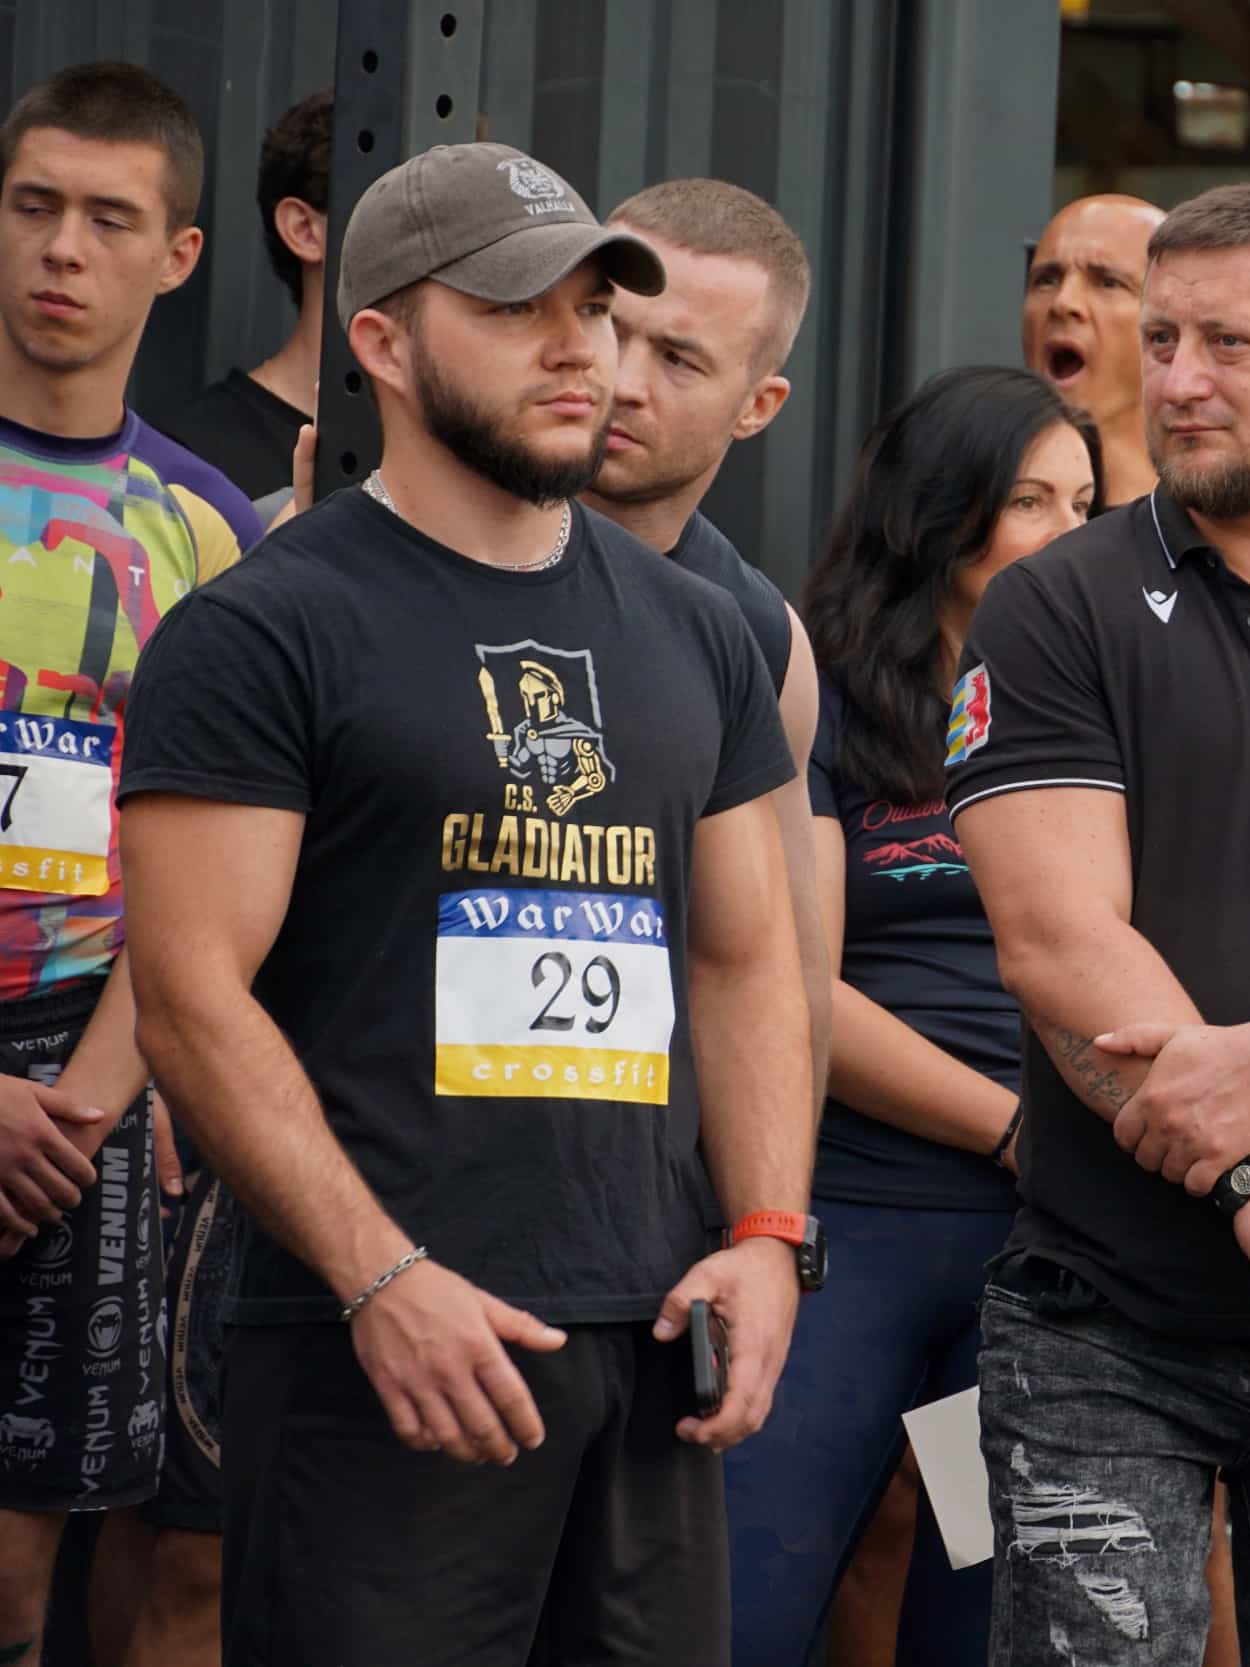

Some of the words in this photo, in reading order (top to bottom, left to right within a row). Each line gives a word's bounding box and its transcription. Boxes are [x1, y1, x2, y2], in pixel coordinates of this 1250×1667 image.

[504, 783, 538, 813] C.S.
[0, 857, 84, 882] sfit
[441, 812, 656, 886] GLADIATOR
[528, 951, 621, 1034] 29
[472, 1059, 655, 1088] crossfit
[98, 1147, 130, 1286] VENUM
[19, 1272, 72, 1288] VENUM
[15, 1296, 61, 1405] VENUM
[82, 1358, 120, 1376] VENUM
[77, 1384, 116, 1498] VENUM
